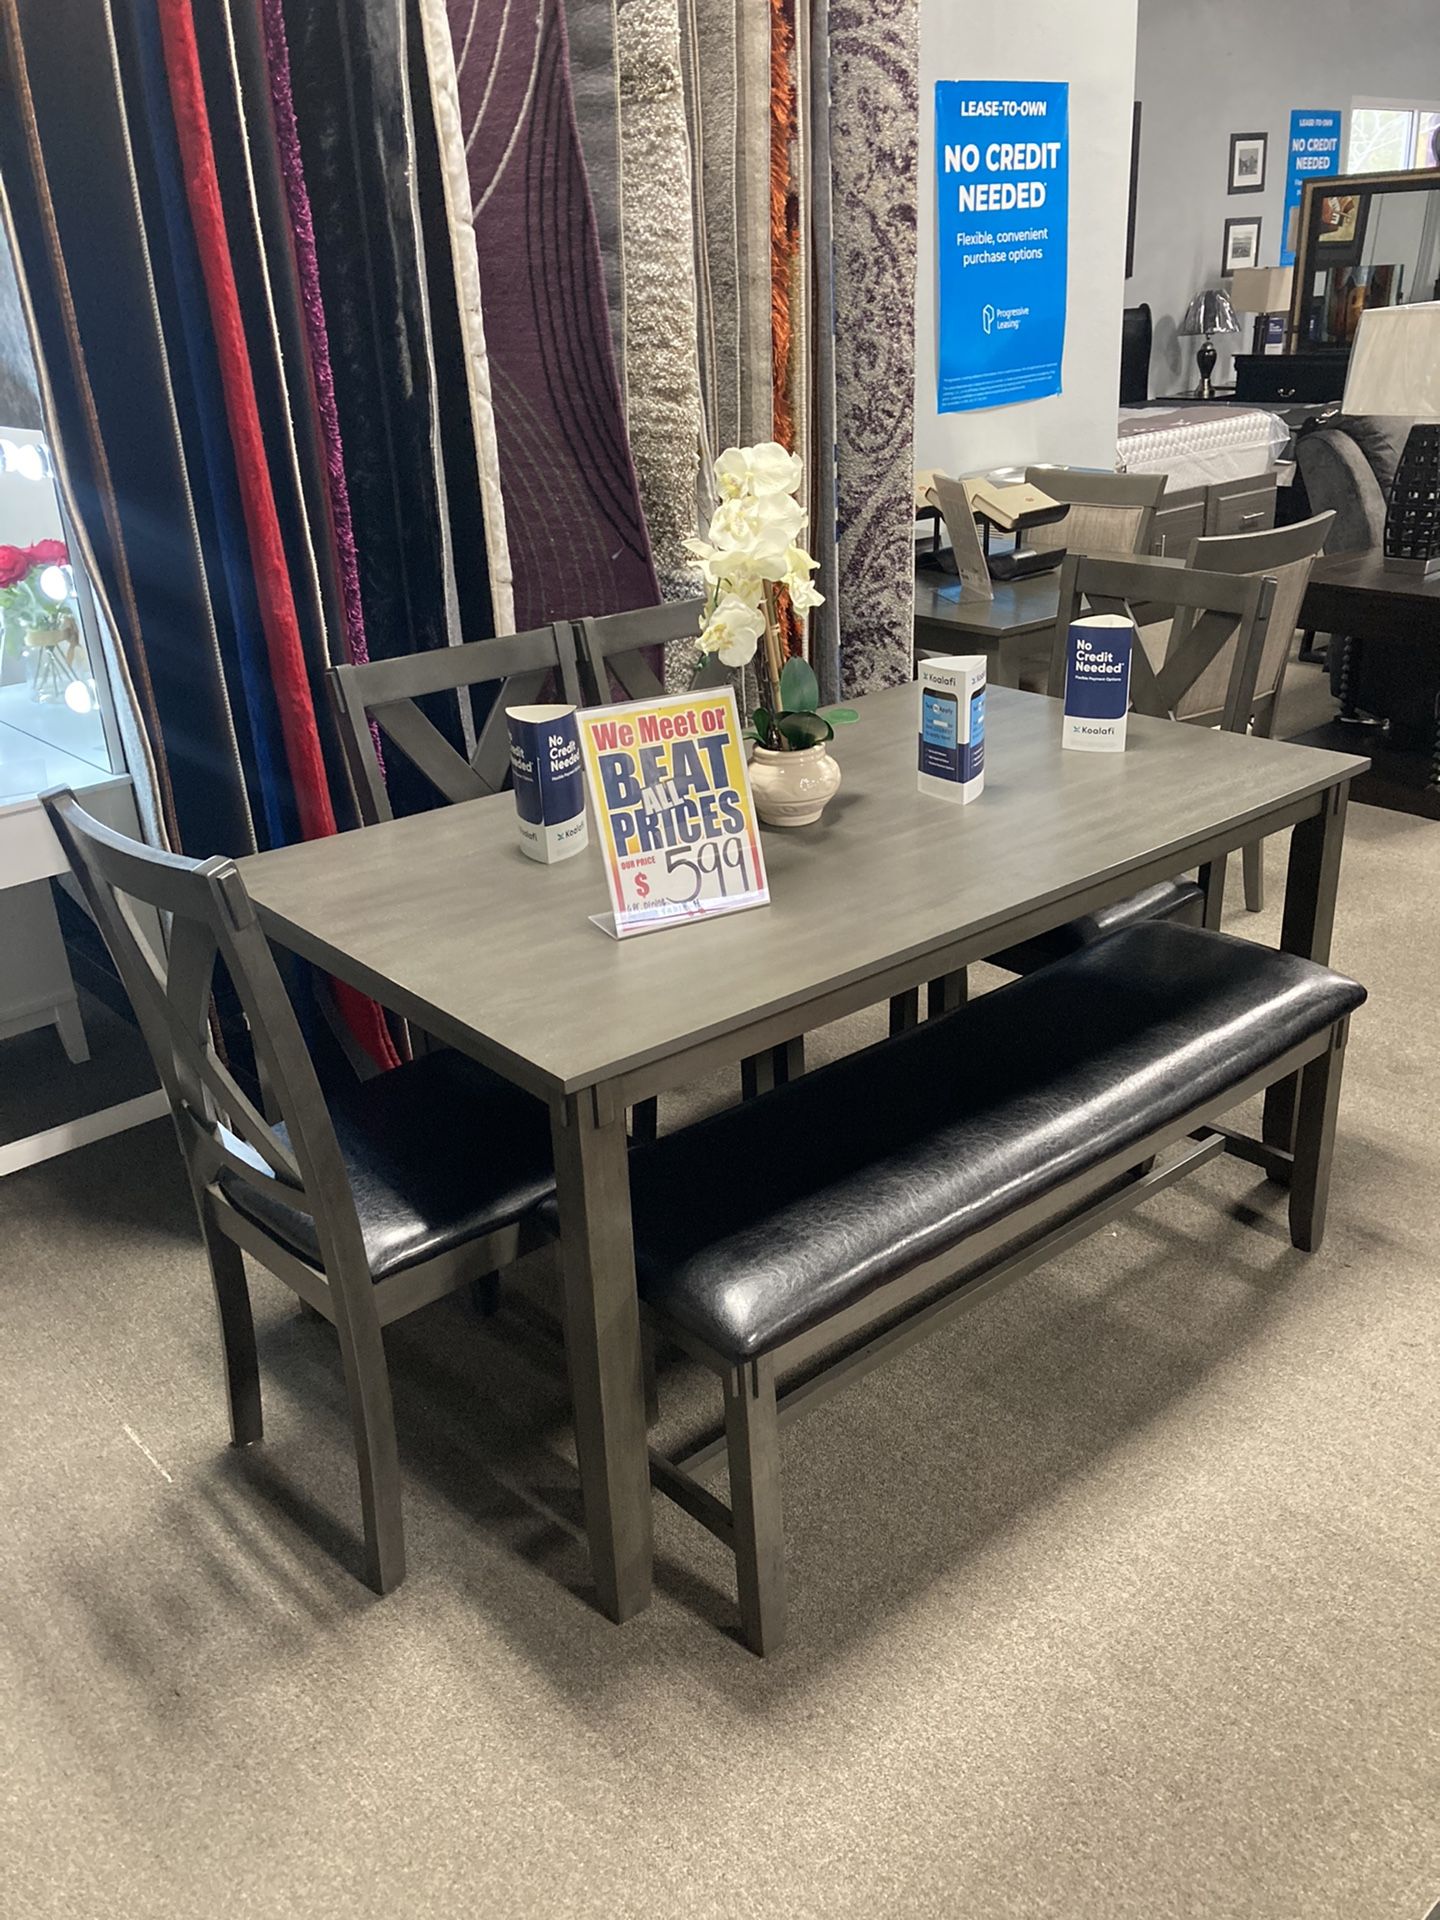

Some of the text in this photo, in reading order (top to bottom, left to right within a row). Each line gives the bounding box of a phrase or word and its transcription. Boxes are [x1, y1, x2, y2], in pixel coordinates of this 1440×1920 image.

[960, 100, 1047, 116] LEASE-TO-OWN
[1292, 138, 1338, 151] NO CREDIT
[944, 142, 1061, 173] NO CREDIT
[1295, 156, 1331, 170] NEEDED
[958, 181, 1047, 213] NEEDED
[956, 228, 1049, 247] Flexible, convenient
[963, 247, 1043, 268] purchase options
[1076, 639, 1093, 651] No
[1076, 650, 1114, 662] Credit
[1075, 661, 1122, 674] Needed
[928, 673, 957, 687] Koalafi
[591, 707, 726, 752] We Meet or
[1081, 725, 1115, 736] Koalafi
[548, 734, 563, 748] No
[550, 747, 580, 772] Needed
[598, 733, 731, 811] BEAT
[640, 778, 686, 816] ALL
[609, 789, 745, 858] PRICES
[621, 855, 656, 871] OUR PRICE
[633, 836, 750, 904] $ 599
